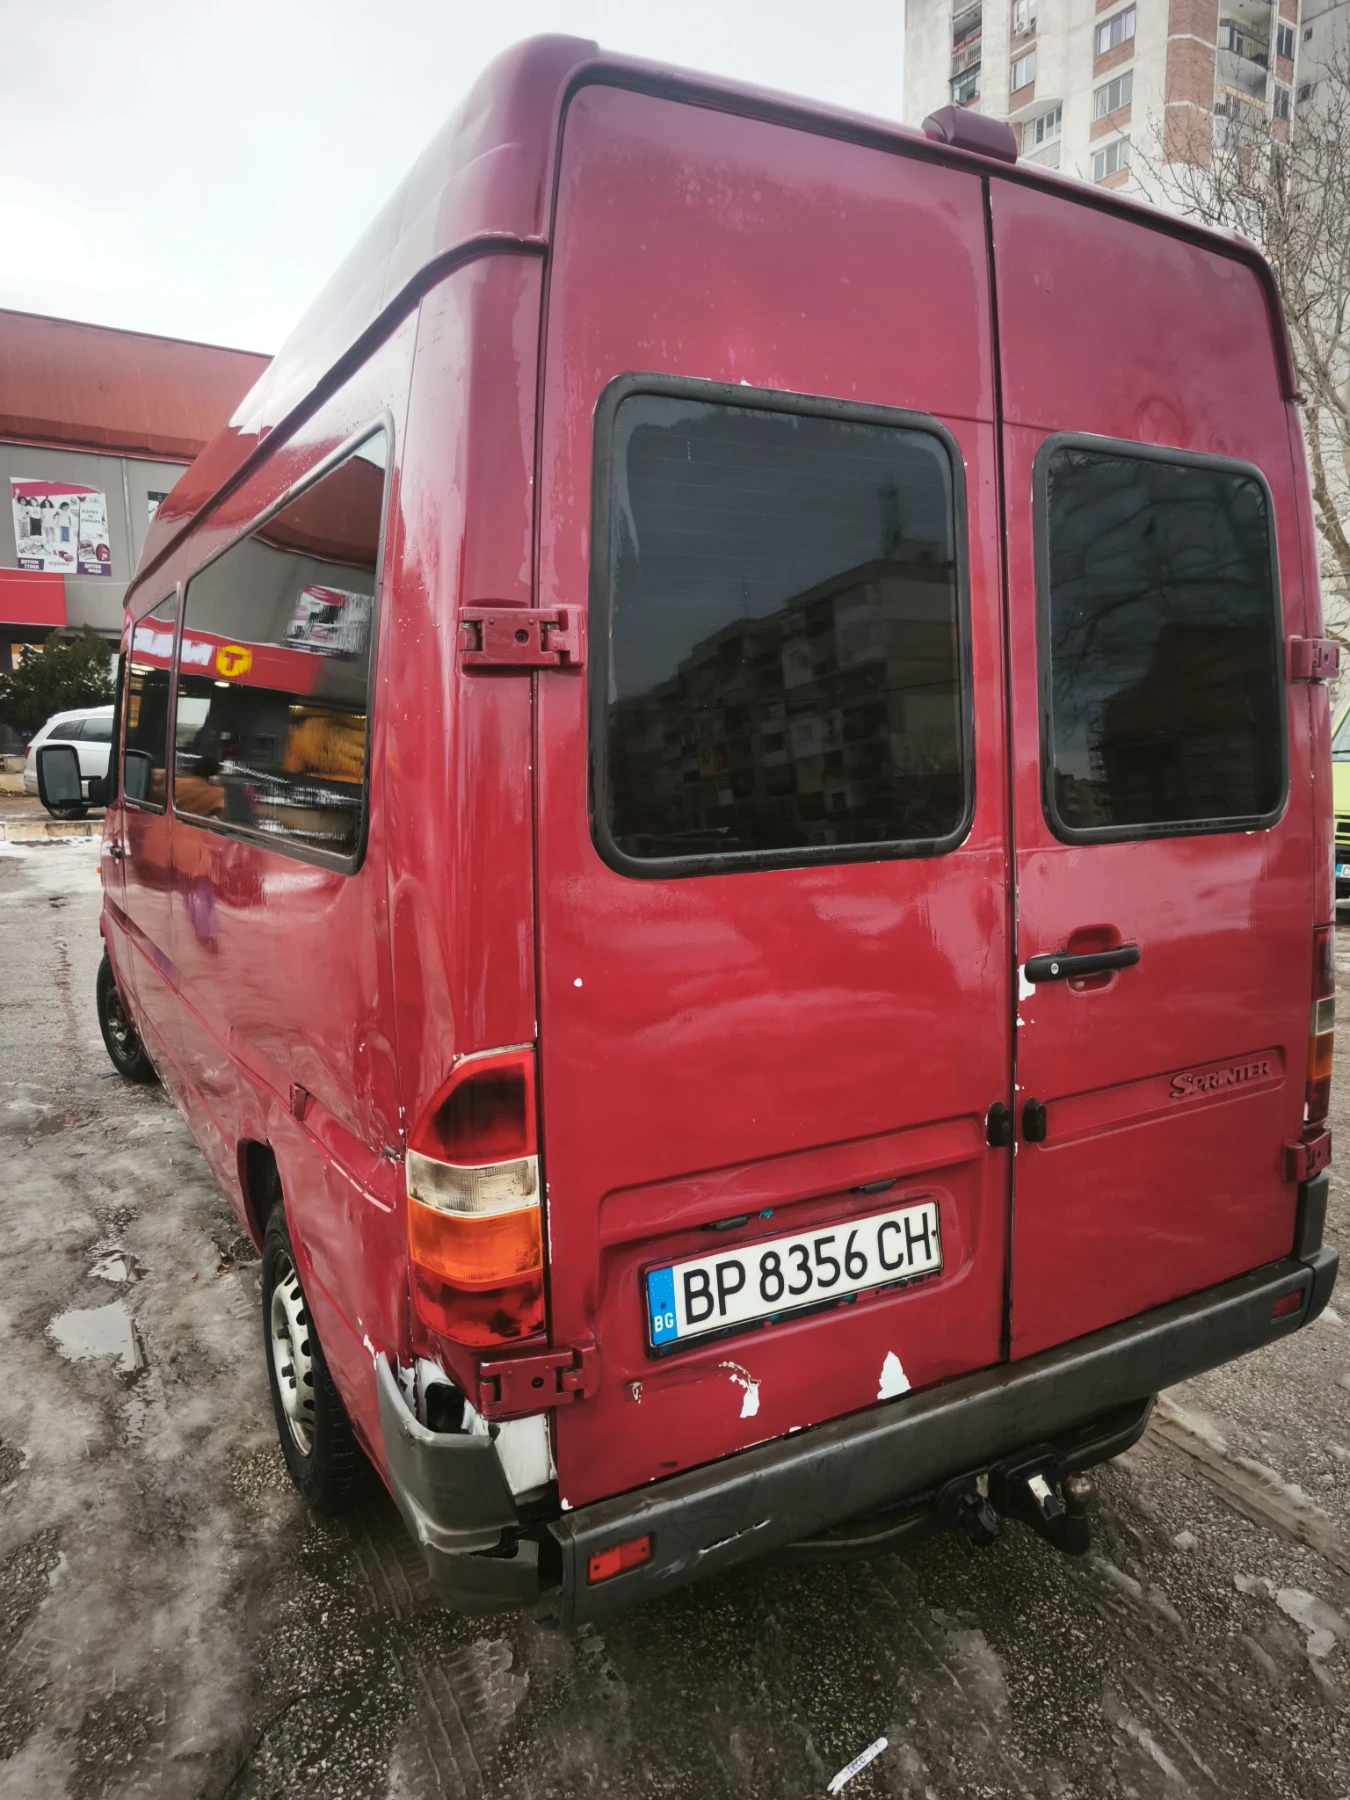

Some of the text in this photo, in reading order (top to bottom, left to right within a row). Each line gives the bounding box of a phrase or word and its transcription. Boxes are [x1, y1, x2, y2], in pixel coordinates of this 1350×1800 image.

[683, 1212, 932, 1326] BP 8356 CH
[653, 1312, 674, 1333] BG
